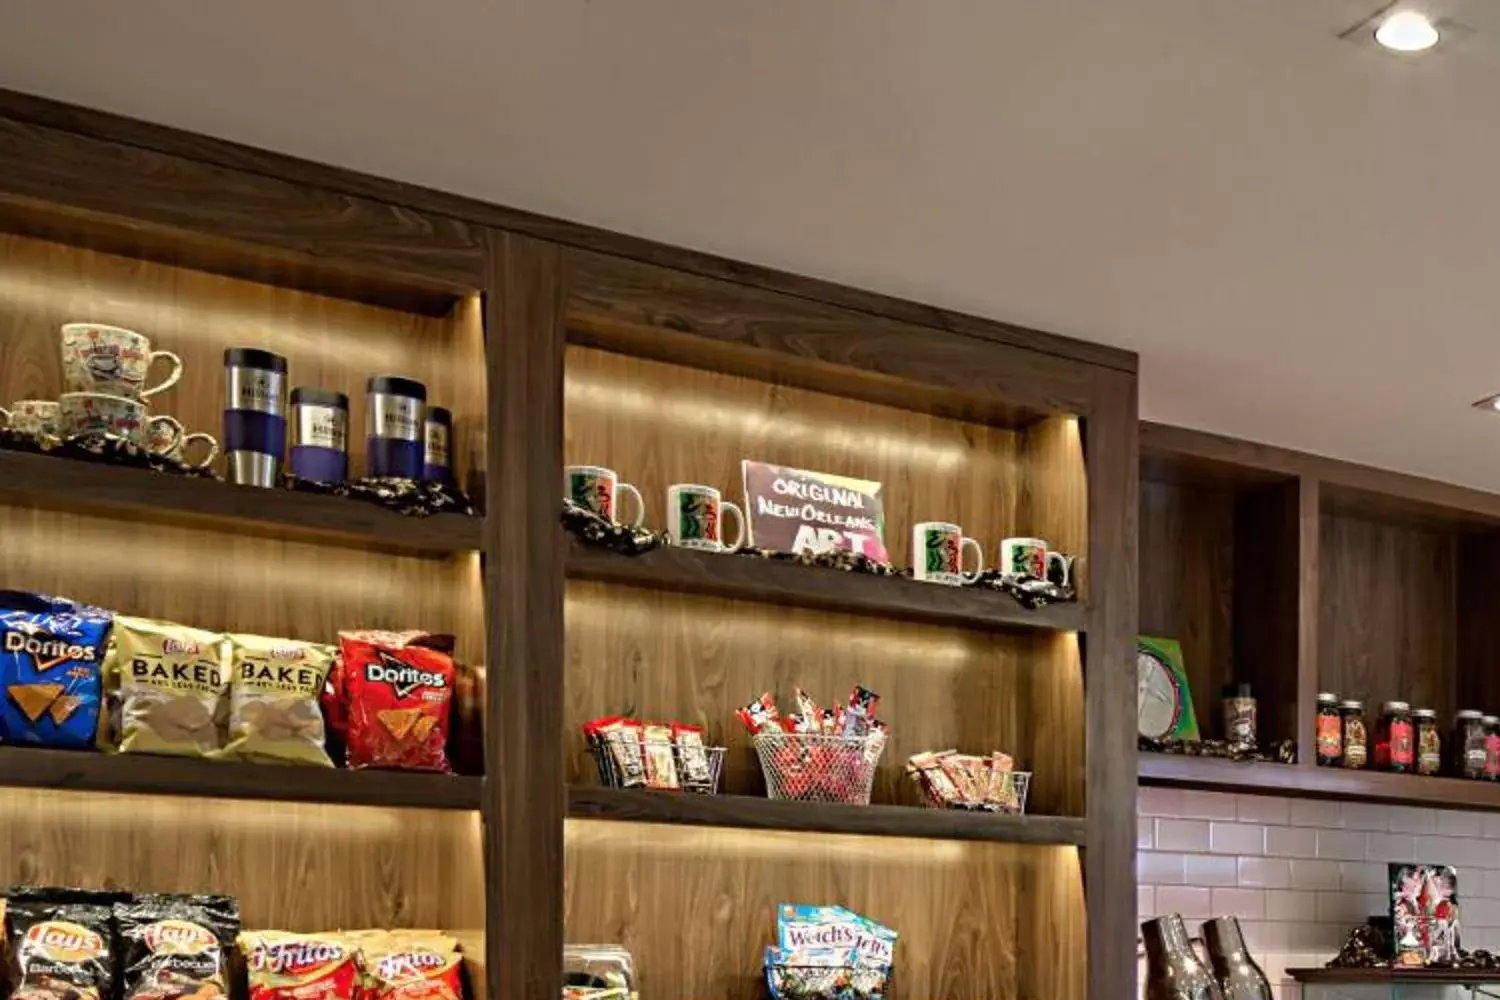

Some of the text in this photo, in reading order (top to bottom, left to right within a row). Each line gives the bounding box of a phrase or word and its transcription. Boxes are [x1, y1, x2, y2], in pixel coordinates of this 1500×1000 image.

[792, 525, 872, 555] ART
[5, 631, 96, 661] Doritos
[132, 659, 221, 687] BAKED
[367, 663, 444, 687] Doritos
